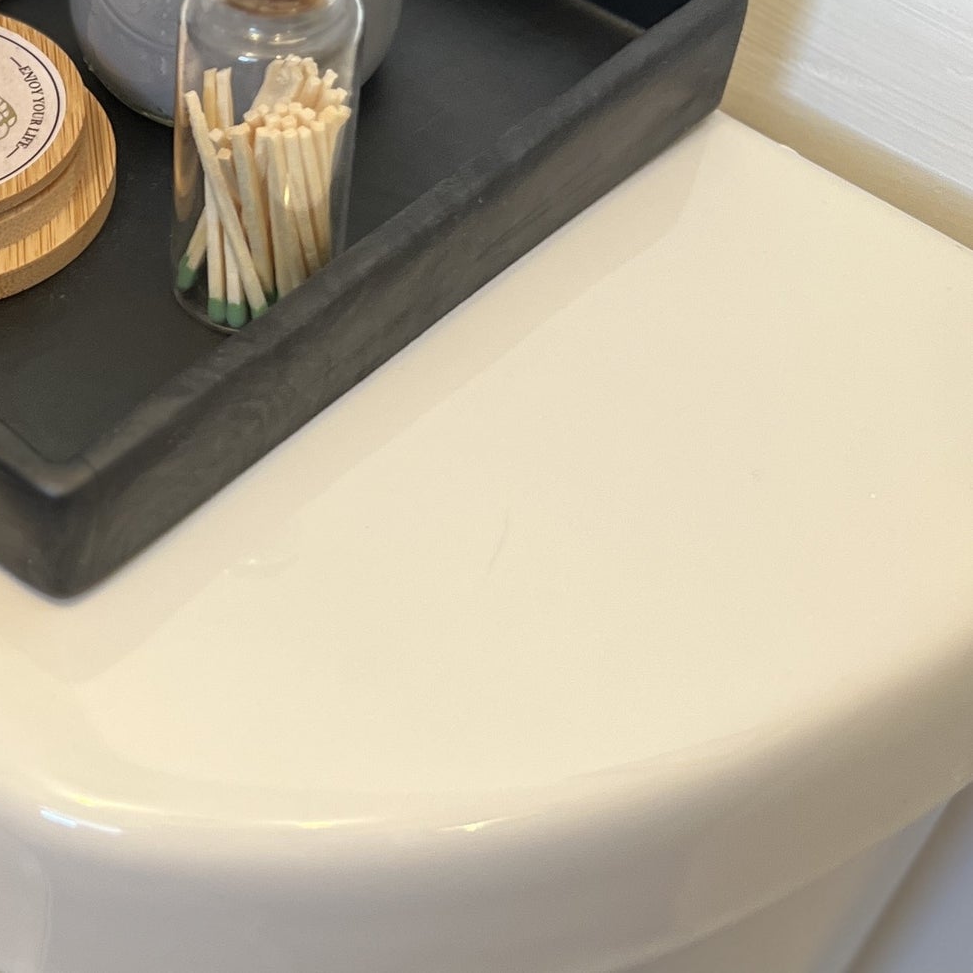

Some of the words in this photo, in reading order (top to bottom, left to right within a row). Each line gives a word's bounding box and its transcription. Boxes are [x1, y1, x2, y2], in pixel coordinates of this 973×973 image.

[19, 65, 45, 95] ENJOY
[30, 96, 46, 126] YOUR
[16, 127, 39, 149] LIFE
